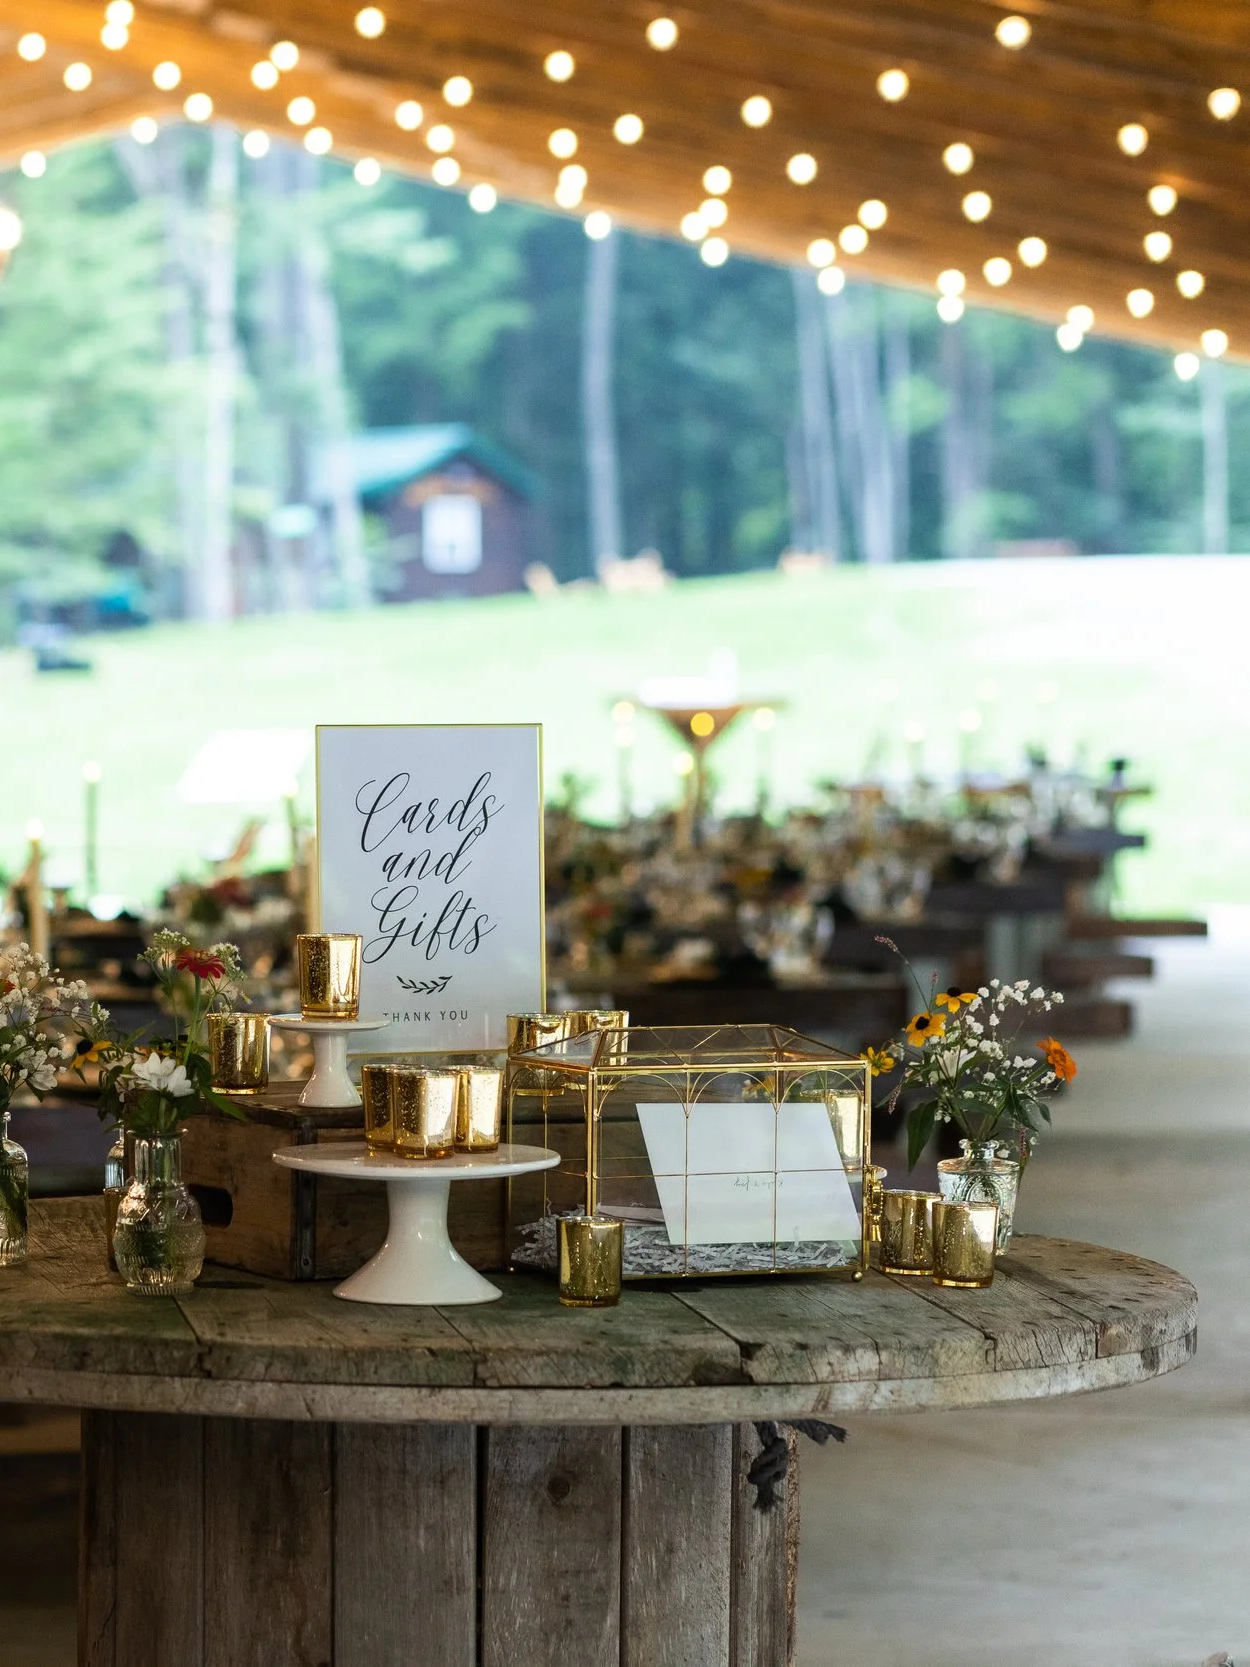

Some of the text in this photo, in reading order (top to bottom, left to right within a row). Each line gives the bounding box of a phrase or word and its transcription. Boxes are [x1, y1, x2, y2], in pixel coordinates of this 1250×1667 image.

[356, 771, 505, 852] Cards
[382, 826, 480, 884] and
[362, 885, 497, 963] Gifts
[439, 1010, 468, 1021] YOU
